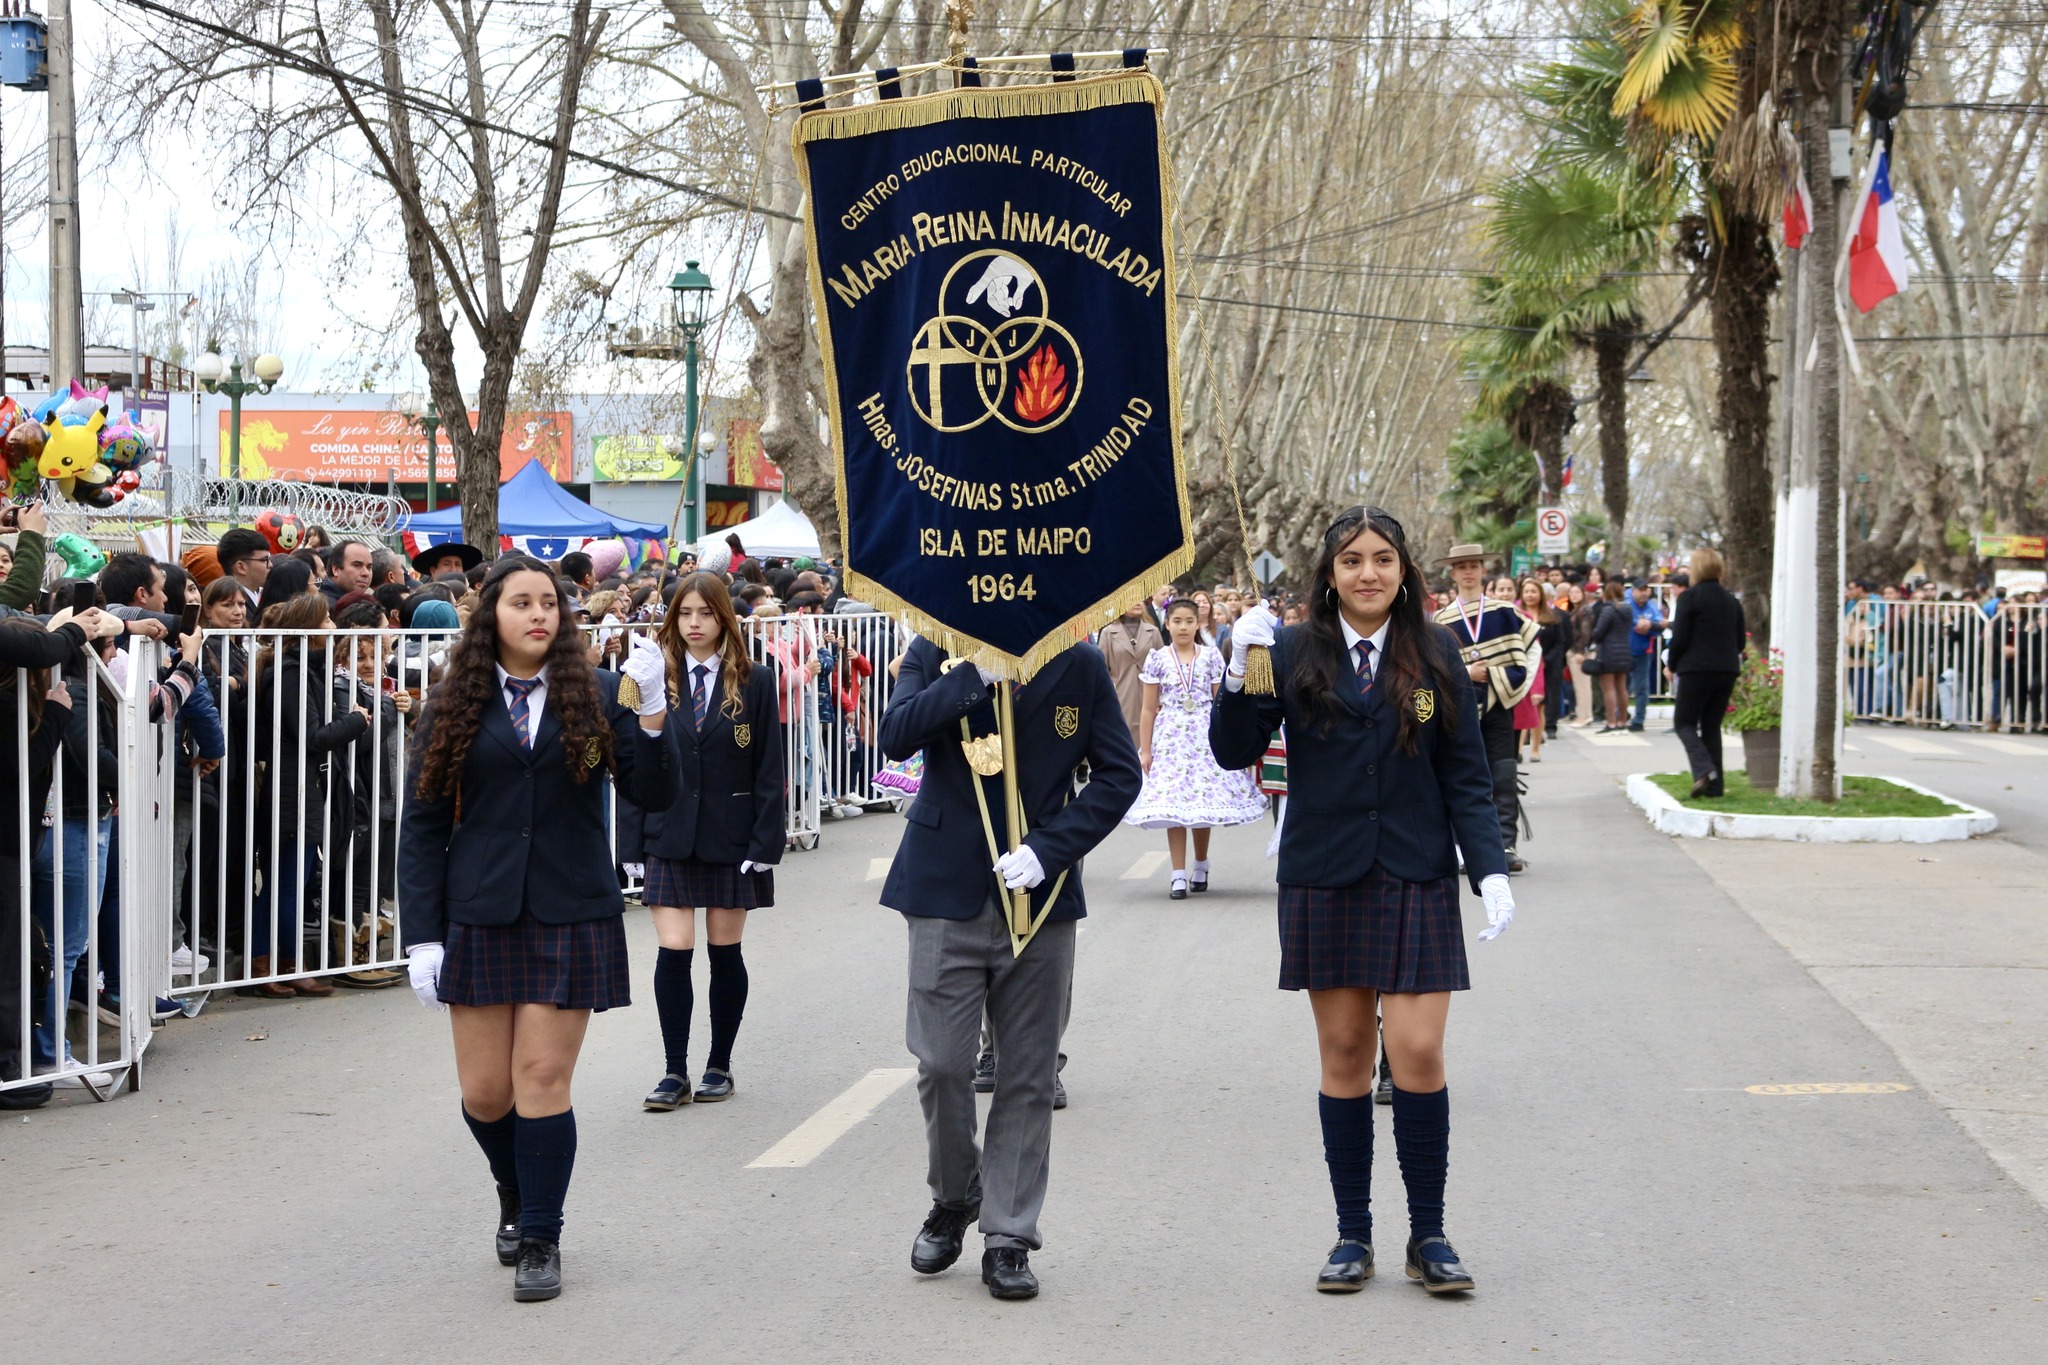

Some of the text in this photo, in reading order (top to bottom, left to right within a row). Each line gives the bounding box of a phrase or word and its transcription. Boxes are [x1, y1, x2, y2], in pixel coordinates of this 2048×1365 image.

[841, 144, 1132, 231] CENTRO EDUCACIONAL PARTICULAR
[827, 201, 1162, 309] MARIA REINA INMACULADA
[966, 328, 1017, 347] J J
[986, 368, 996, 386] M
[301, 413, 335, 435] Lu
[335, 421, 371, 442] yin
[310, 443, 360, 454] COMIDA
[362, 443, 402, 455] CHINA
[412, 444, 453, 455] CATO
[322, 454, 456, 466] LA MEJOR DE LA ZNA
[896, 453, 1002, 511] JOSEFINAS
[1011, 476, 1077, 510] Stma.
[1068, 397, 1153, 488] TRINIDAD
[920, 527, 1092, 557] ISLA DE MAIPO
[967, 573, 1037, 604] 1964
